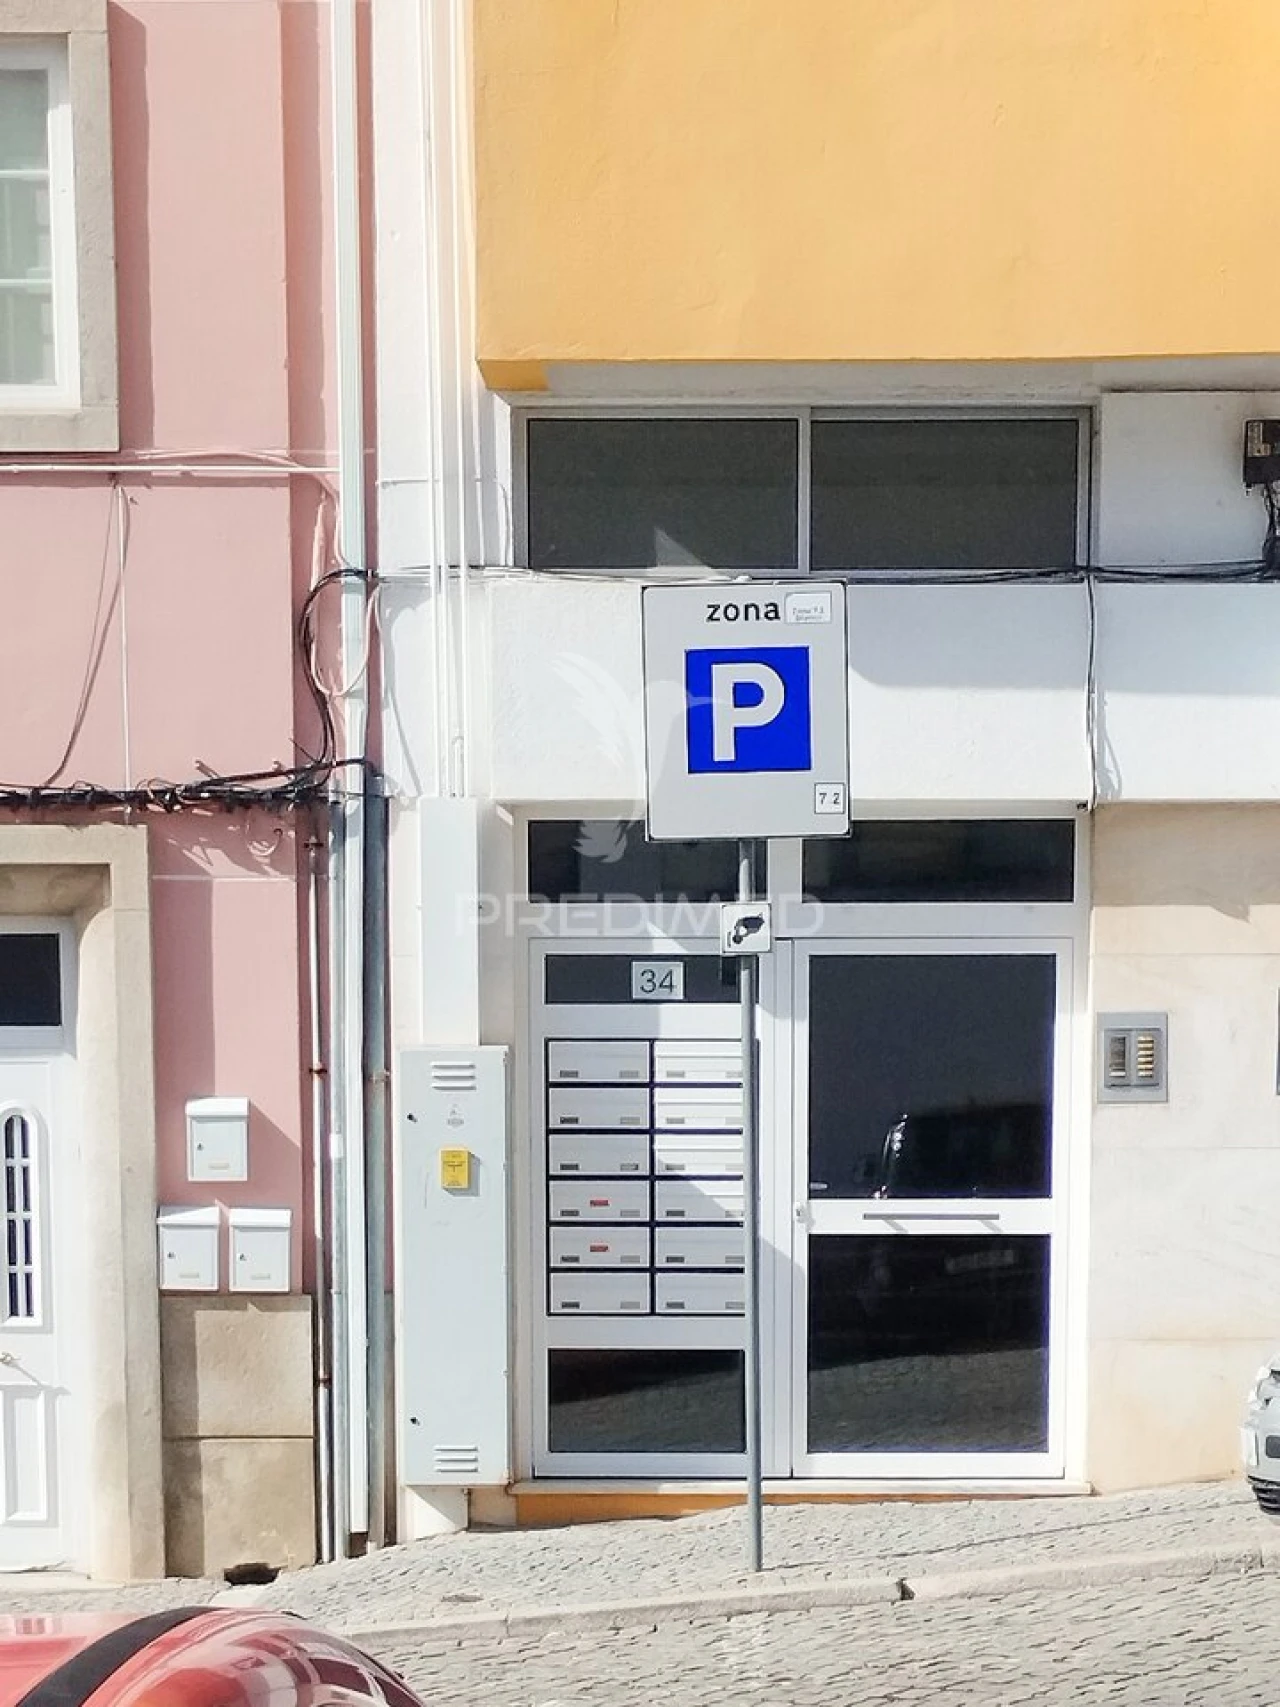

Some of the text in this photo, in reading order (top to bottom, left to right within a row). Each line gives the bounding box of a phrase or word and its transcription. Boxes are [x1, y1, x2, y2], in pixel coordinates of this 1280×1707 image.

[706, 602, 781, 622] zona
[711, 663, 785, 762] P
[639, 969, 677, 993] 34
